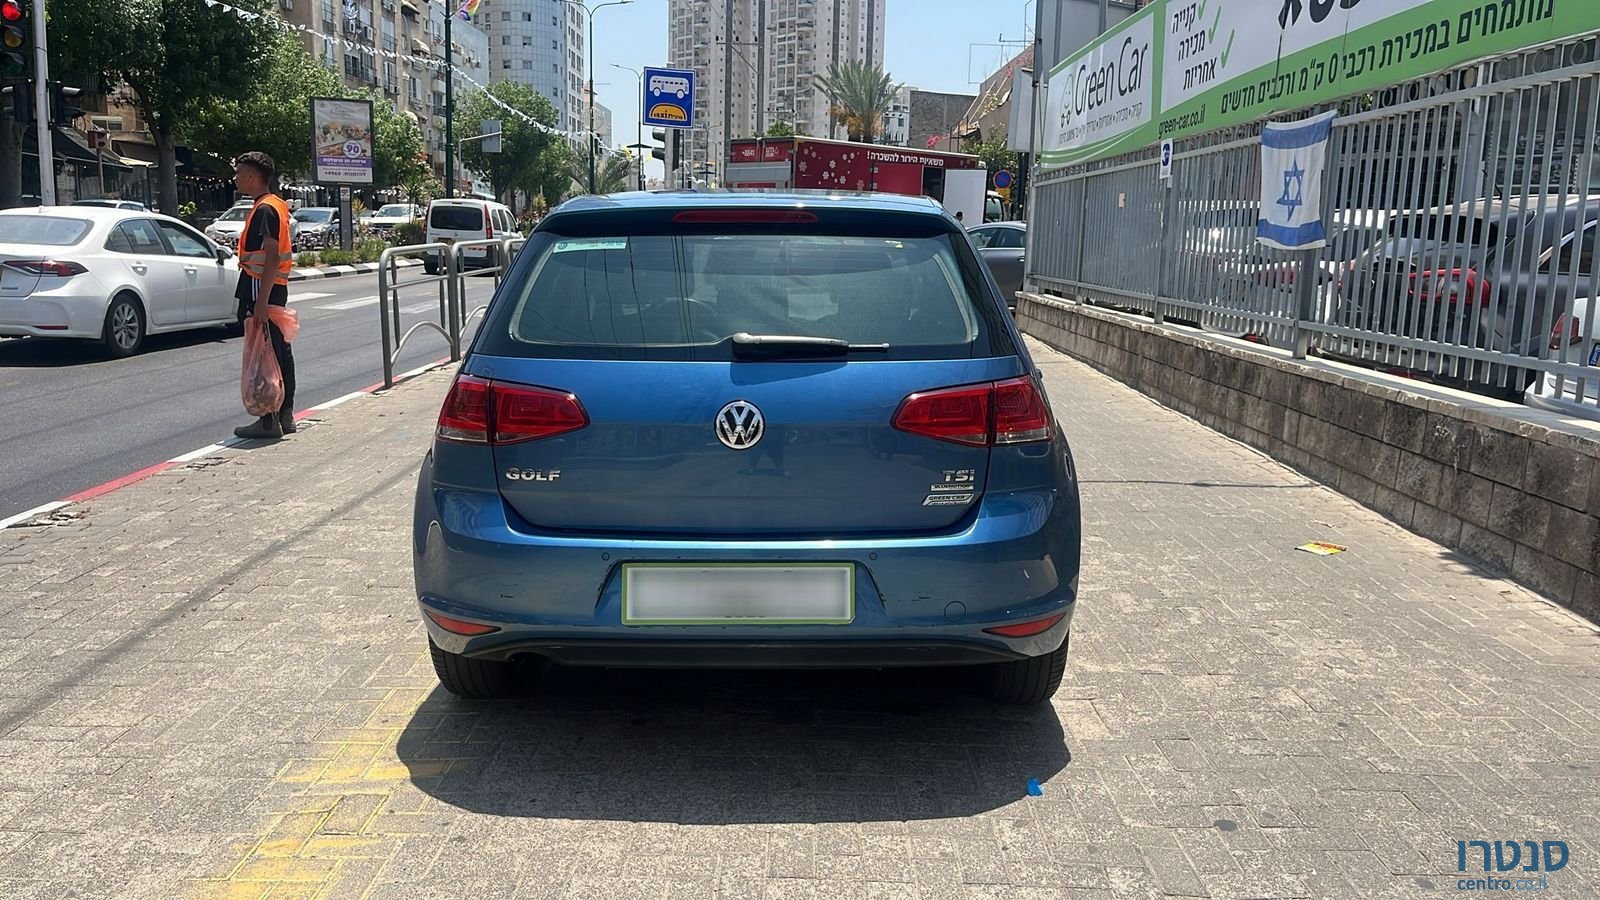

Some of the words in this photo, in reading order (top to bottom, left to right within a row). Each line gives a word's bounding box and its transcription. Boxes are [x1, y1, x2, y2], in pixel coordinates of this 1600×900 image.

[1172, 3, 1197, 34] קנייה
[1178, 30, 1206, 61] מכירה
[1379, 20, 1450, 69] במכירת
[1075, 62, 1115, 116] Green
[1118, 36, 1148, 97] Car
[1183, 57, 1217, 91] אחריות
[1343, 45, 1376, 79] רכבי
[1221, 85, 1255, 114] חדשים
[1258, 71, 1296, 104] ורכבים
[1159, 104, 1206, 139] green-car.co.il
[346, 145, 360, 153] 90
[867, 151, 900, 162] להשכרה!
[505, 467, 561, 481] GOLF
